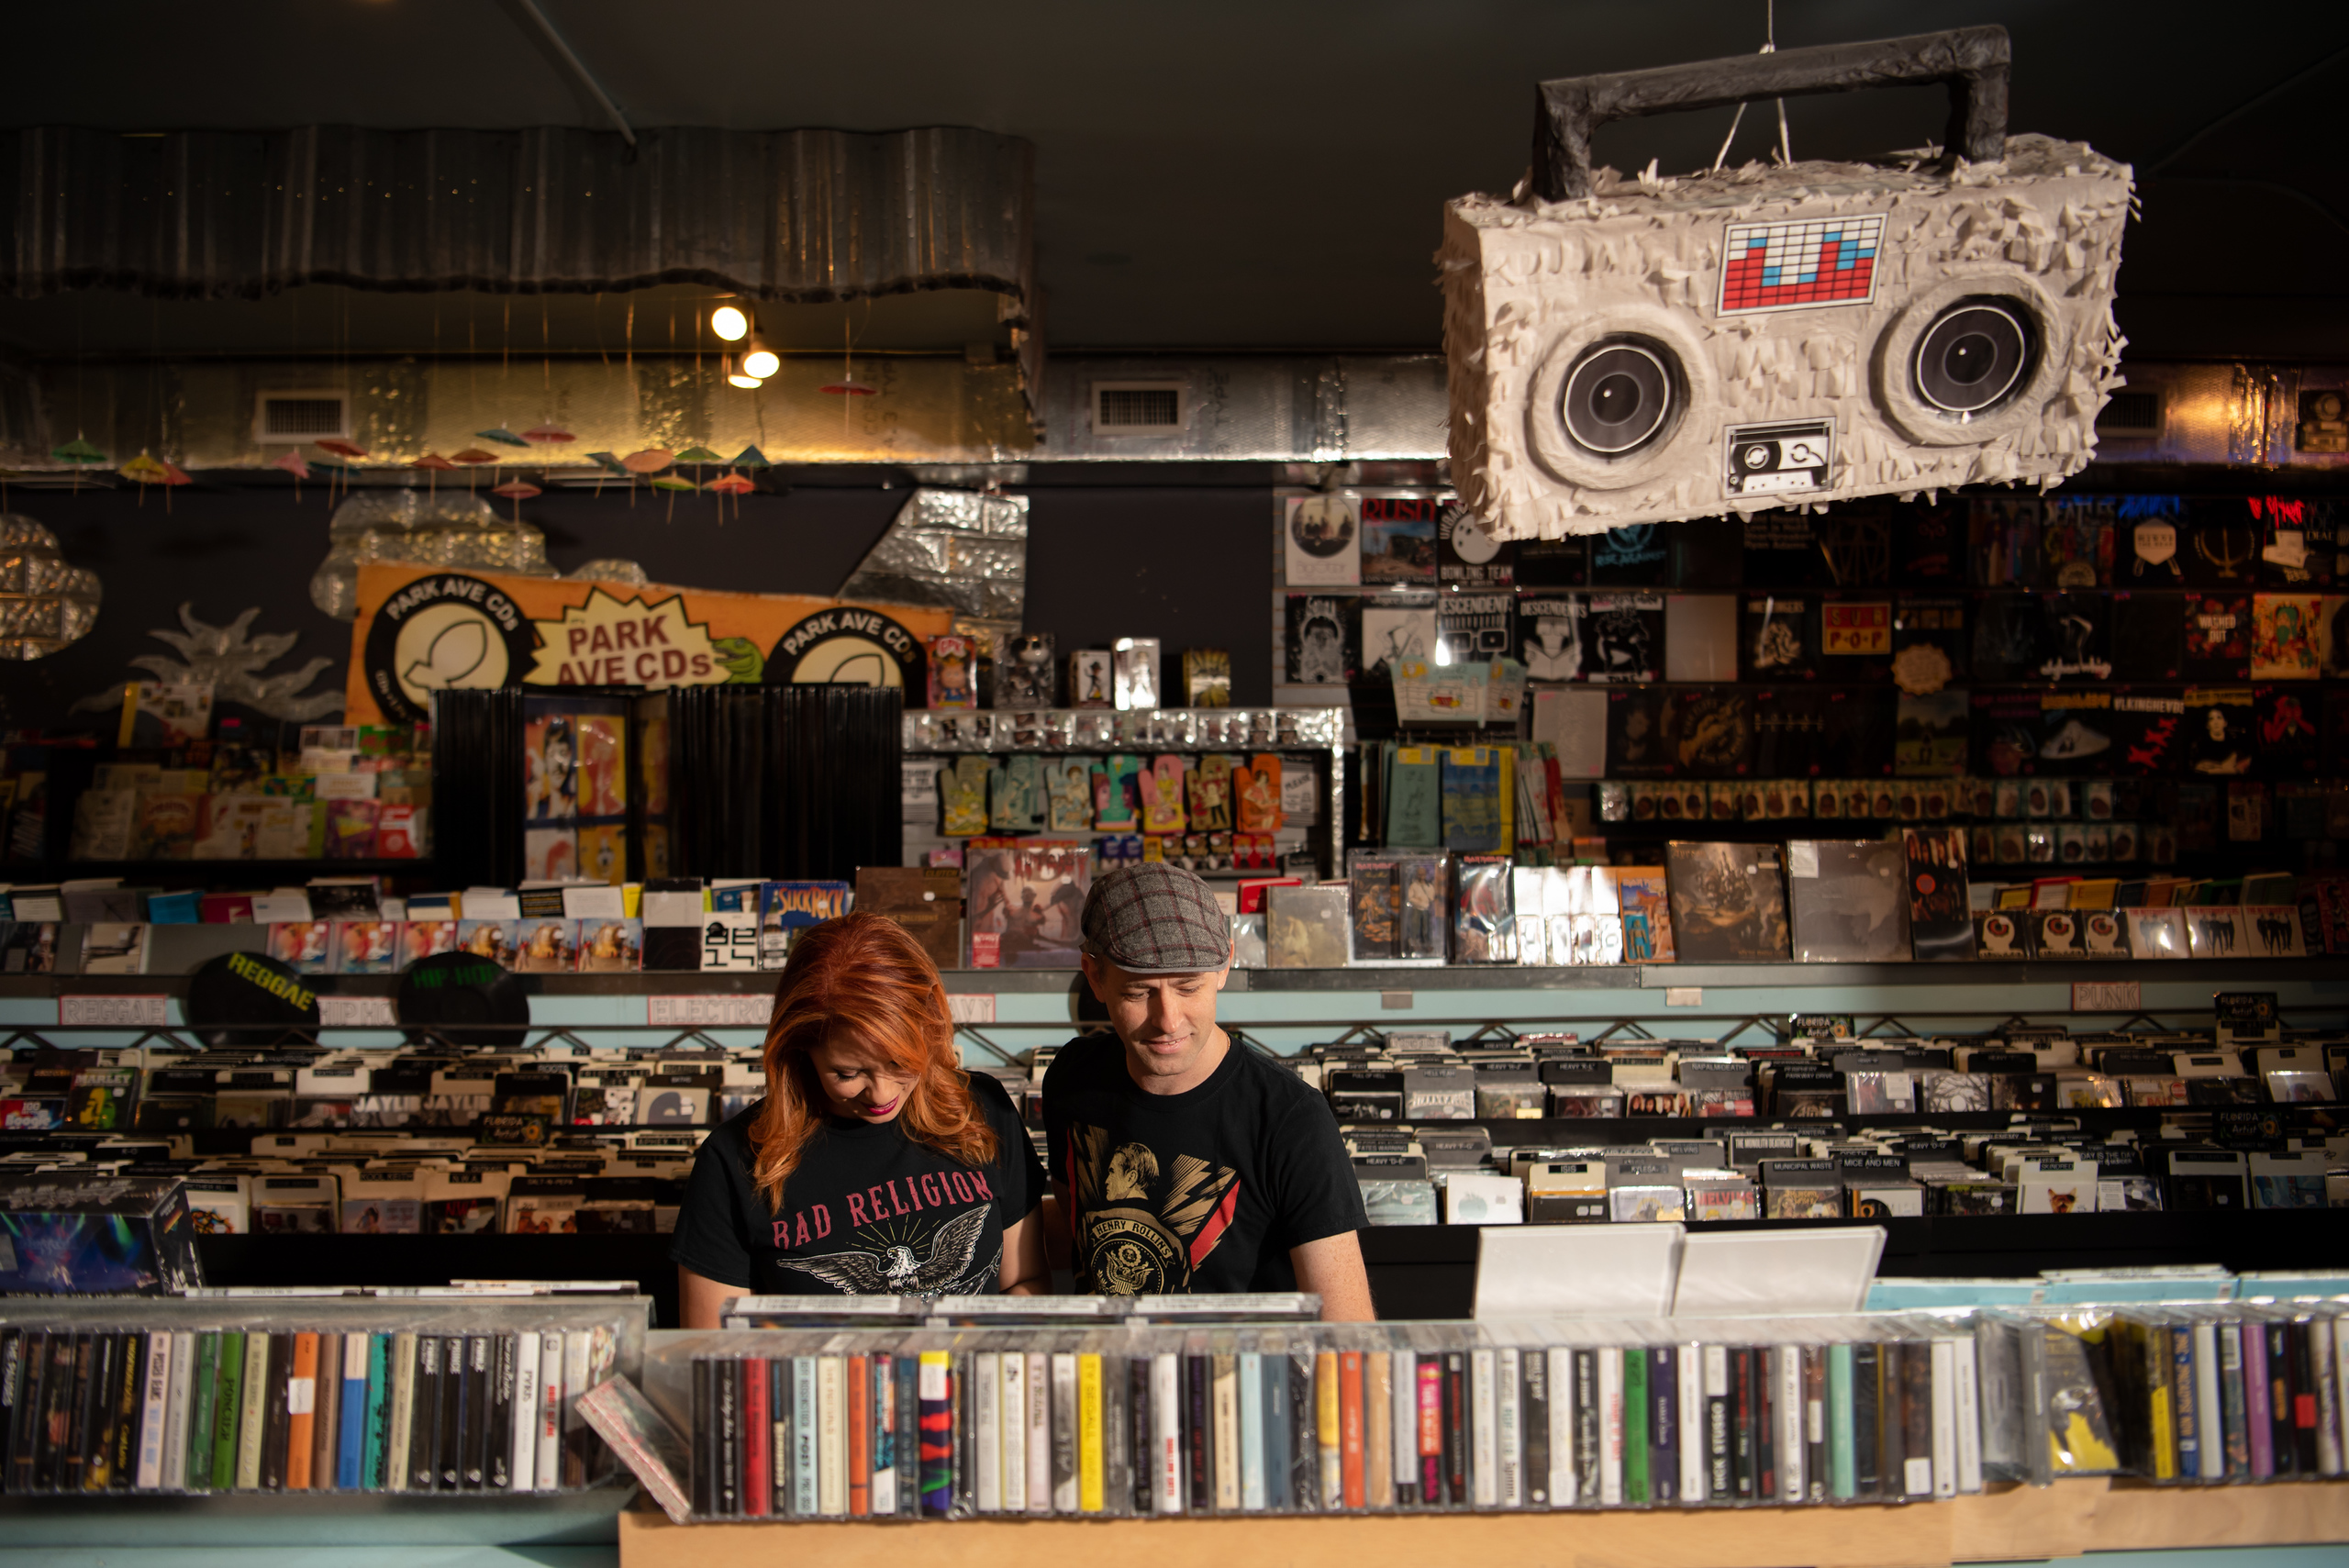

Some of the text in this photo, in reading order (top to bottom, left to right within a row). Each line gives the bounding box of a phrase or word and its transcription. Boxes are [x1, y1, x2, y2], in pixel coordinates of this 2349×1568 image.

[385, 577, 519, 631] PARK AVE CDs
[2199, 613, 2237, 629] WASHED
[568, 615, 669, 657] PARK
[783, 612, 837, 657] PARK
[839, 611, 884, 636] AVE
[2208, 628, 2227, 643] OUT
[558, 650, 712, 686] AVE CDs
[778, 886, 845, 920] SLICK RICK
[228, 952, 316, 1011] REGGAE
[2076, 986, 2138, 1009] PUNK
[2221, 995, 2254, 1007] FLORIDA
[63, 999, 163, 1025] REGGAE
[321, 999, 357, 1025] HIP
[2231, 1006, 2254, 1018] Artist
[1797, 1017, 1831, 1028] FLORIDA
[1808, 1028, 1829, 1038] Artist
[538, 1064, 569, 1073] ROOTS
[1720, 1063, 1744, 1072] DEATH
[74, 1073, 131, 1086] MARLEY
[22, 1101, 40, 1111] 100
[354, 1095, 421, 1112] JAYLIB
[424, 1095, 491, 1112] JAYLIB
[6, 1113, 52, 1128] Boogie
[484, 1117, 524, 1128] FLORIDA
[2221, 1112, 2259, 1122] FLORIDA
[495, 1128, 521, 1140] Artist
[2232, 1124, 2258, 1135] Artist
[1744, 1138, 1768, 1149] MONOLITH
[1775, 1162, 1833, 1171] MUNICIPAL WASTE
[2041, 1162, 2074, 1171] SKINDRED
[846, 1171, 994, 1228] RELIGION
[1698, 1193, 1754, 1207] MELVINS
[772, 1204, 832, 1251] BAD
[1097, 1220, 1171, 1256] HENRY ROLLINS
